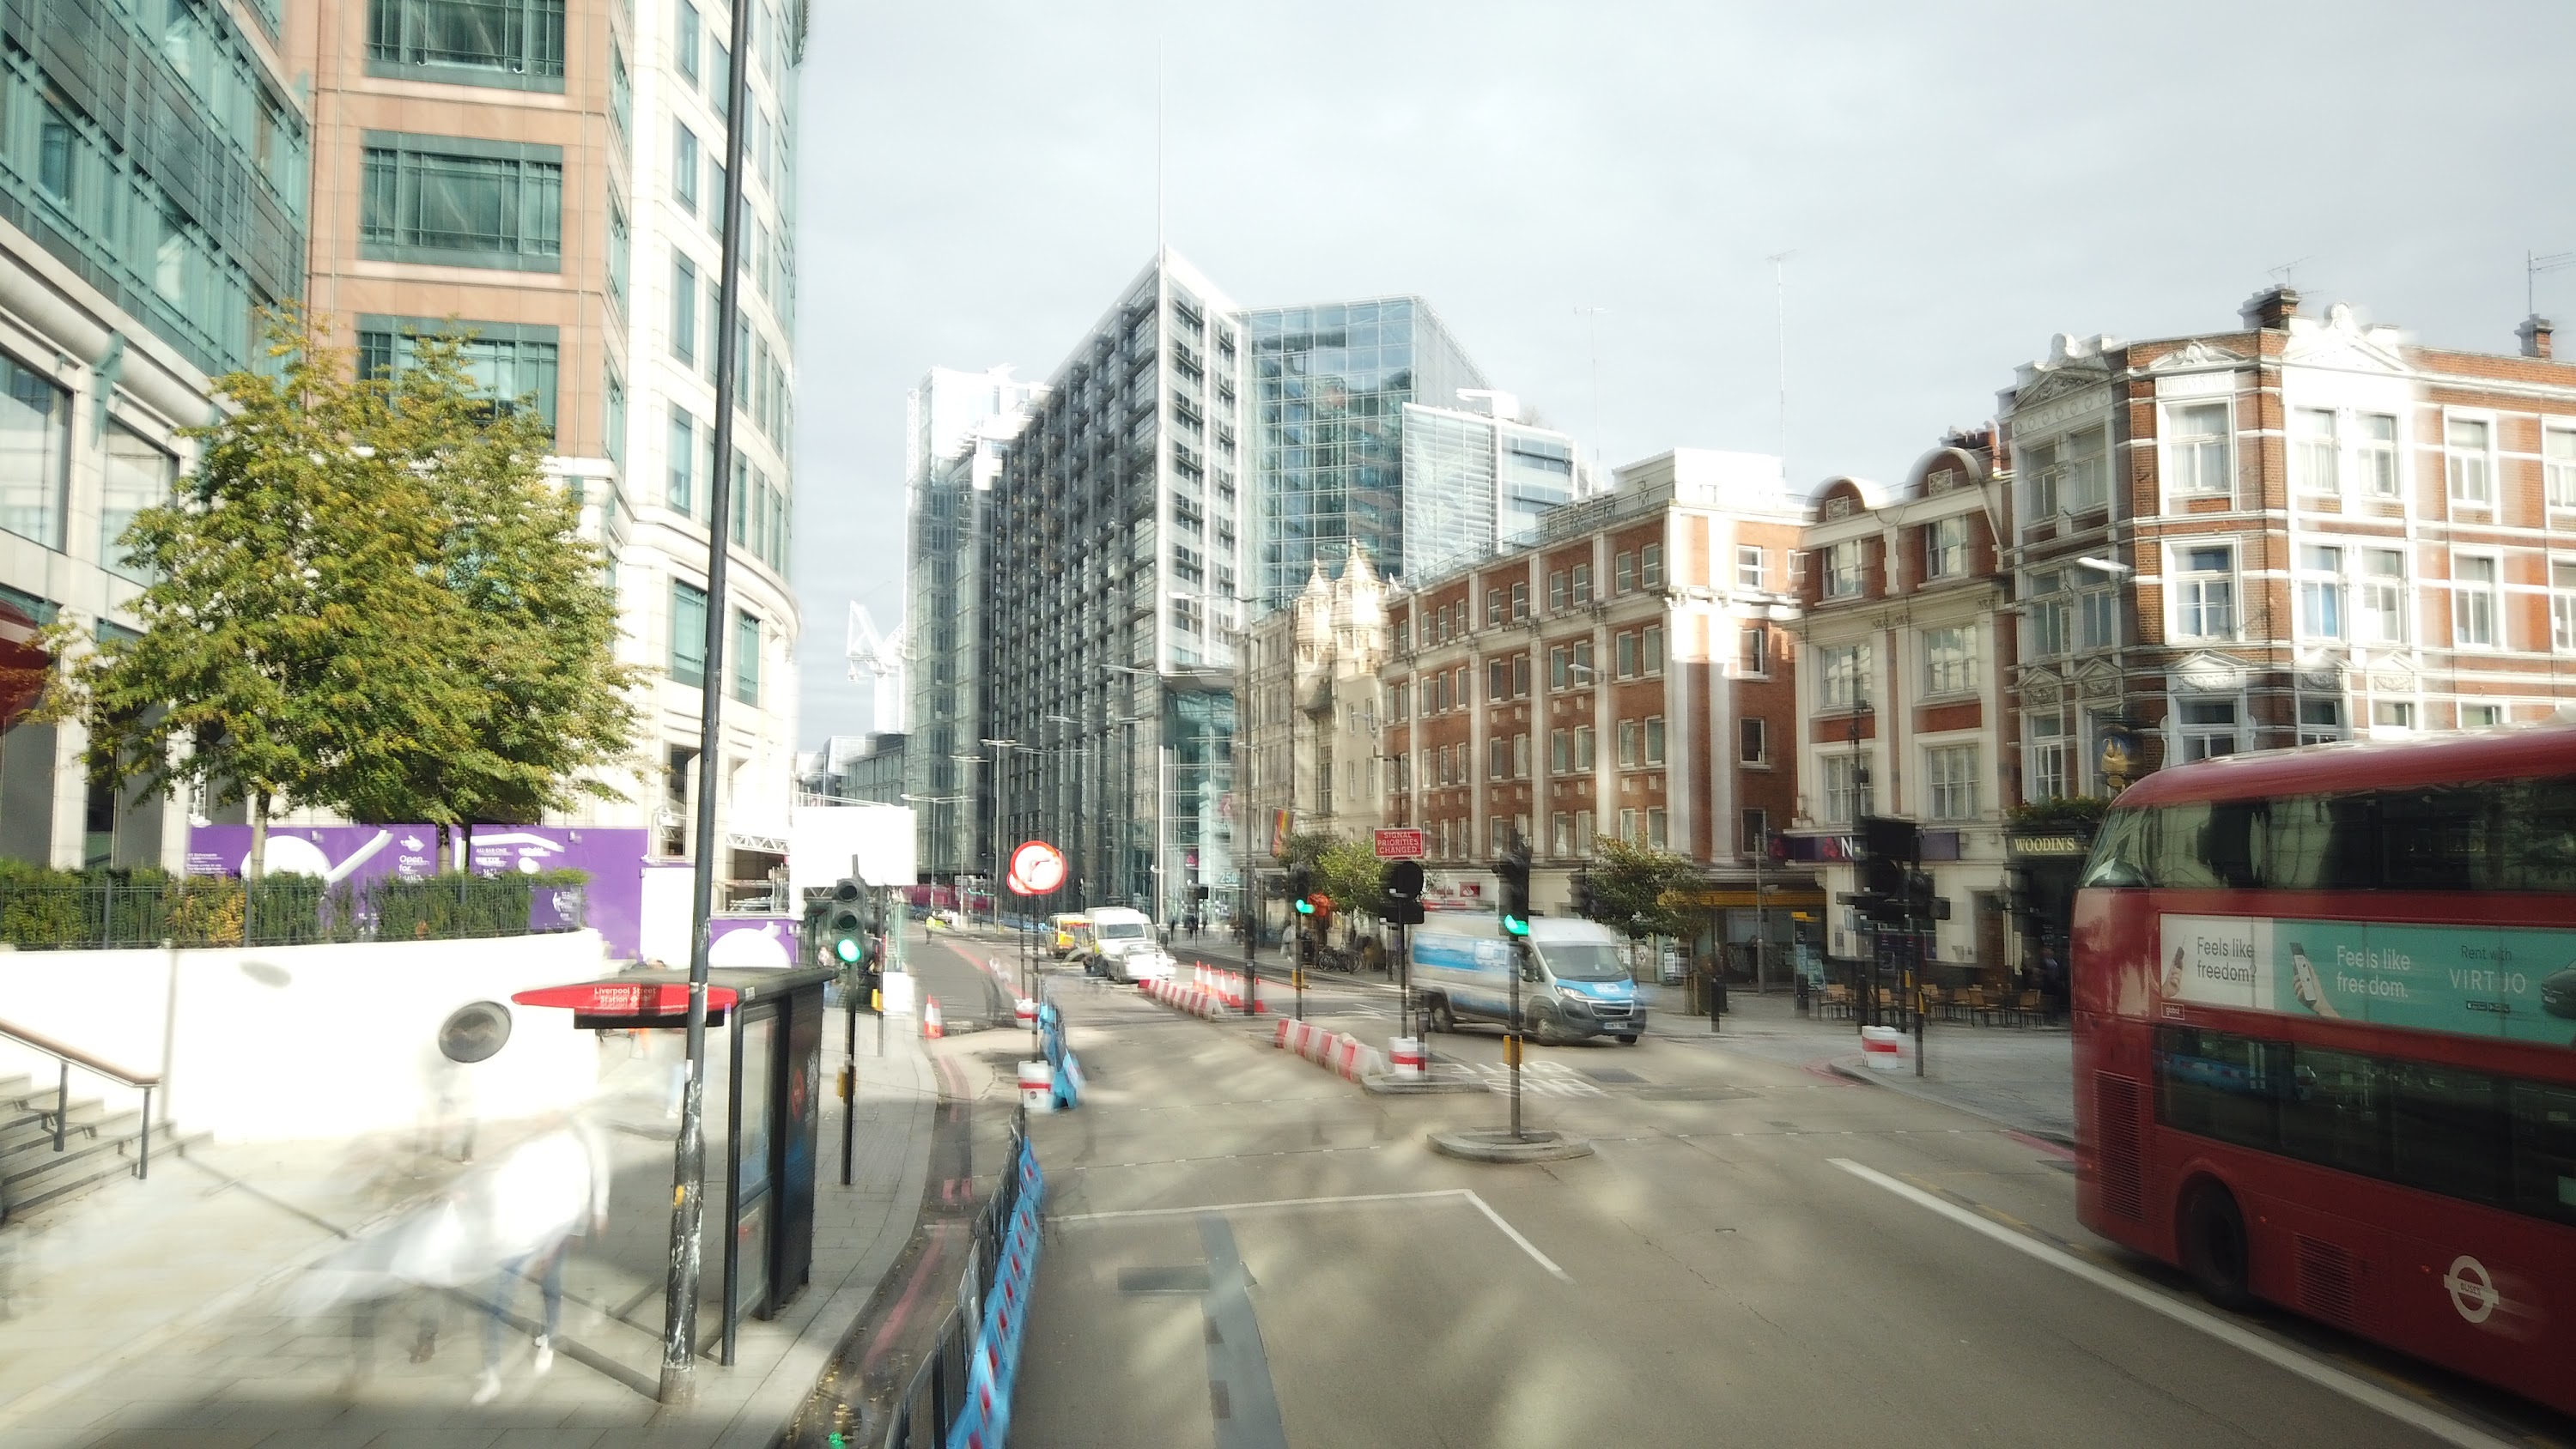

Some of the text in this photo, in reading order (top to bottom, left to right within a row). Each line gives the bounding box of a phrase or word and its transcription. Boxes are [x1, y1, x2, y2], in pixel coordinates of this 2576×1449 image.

[1383, 831, 1413, 840] SIGNAL
[2014, 837, 2075, 852] WOODIN'S
[399, 855, 423, 866] Open
[399, 864, 412, 872] for
[1220, 872, 1237, 883] 250
[2197, 937, 2255, 958] Feels like
[2461, 945, 2486, 960] Rent
[2336, 945, 2411, 971] Feels like
[2197, 960, 2257, 982] freedom?
[594, 986, 656, 996] Liverpool Street
[2336, 971, 2409, 998] freedom.
[2460, 1282, 2482, 1295] BUSES
